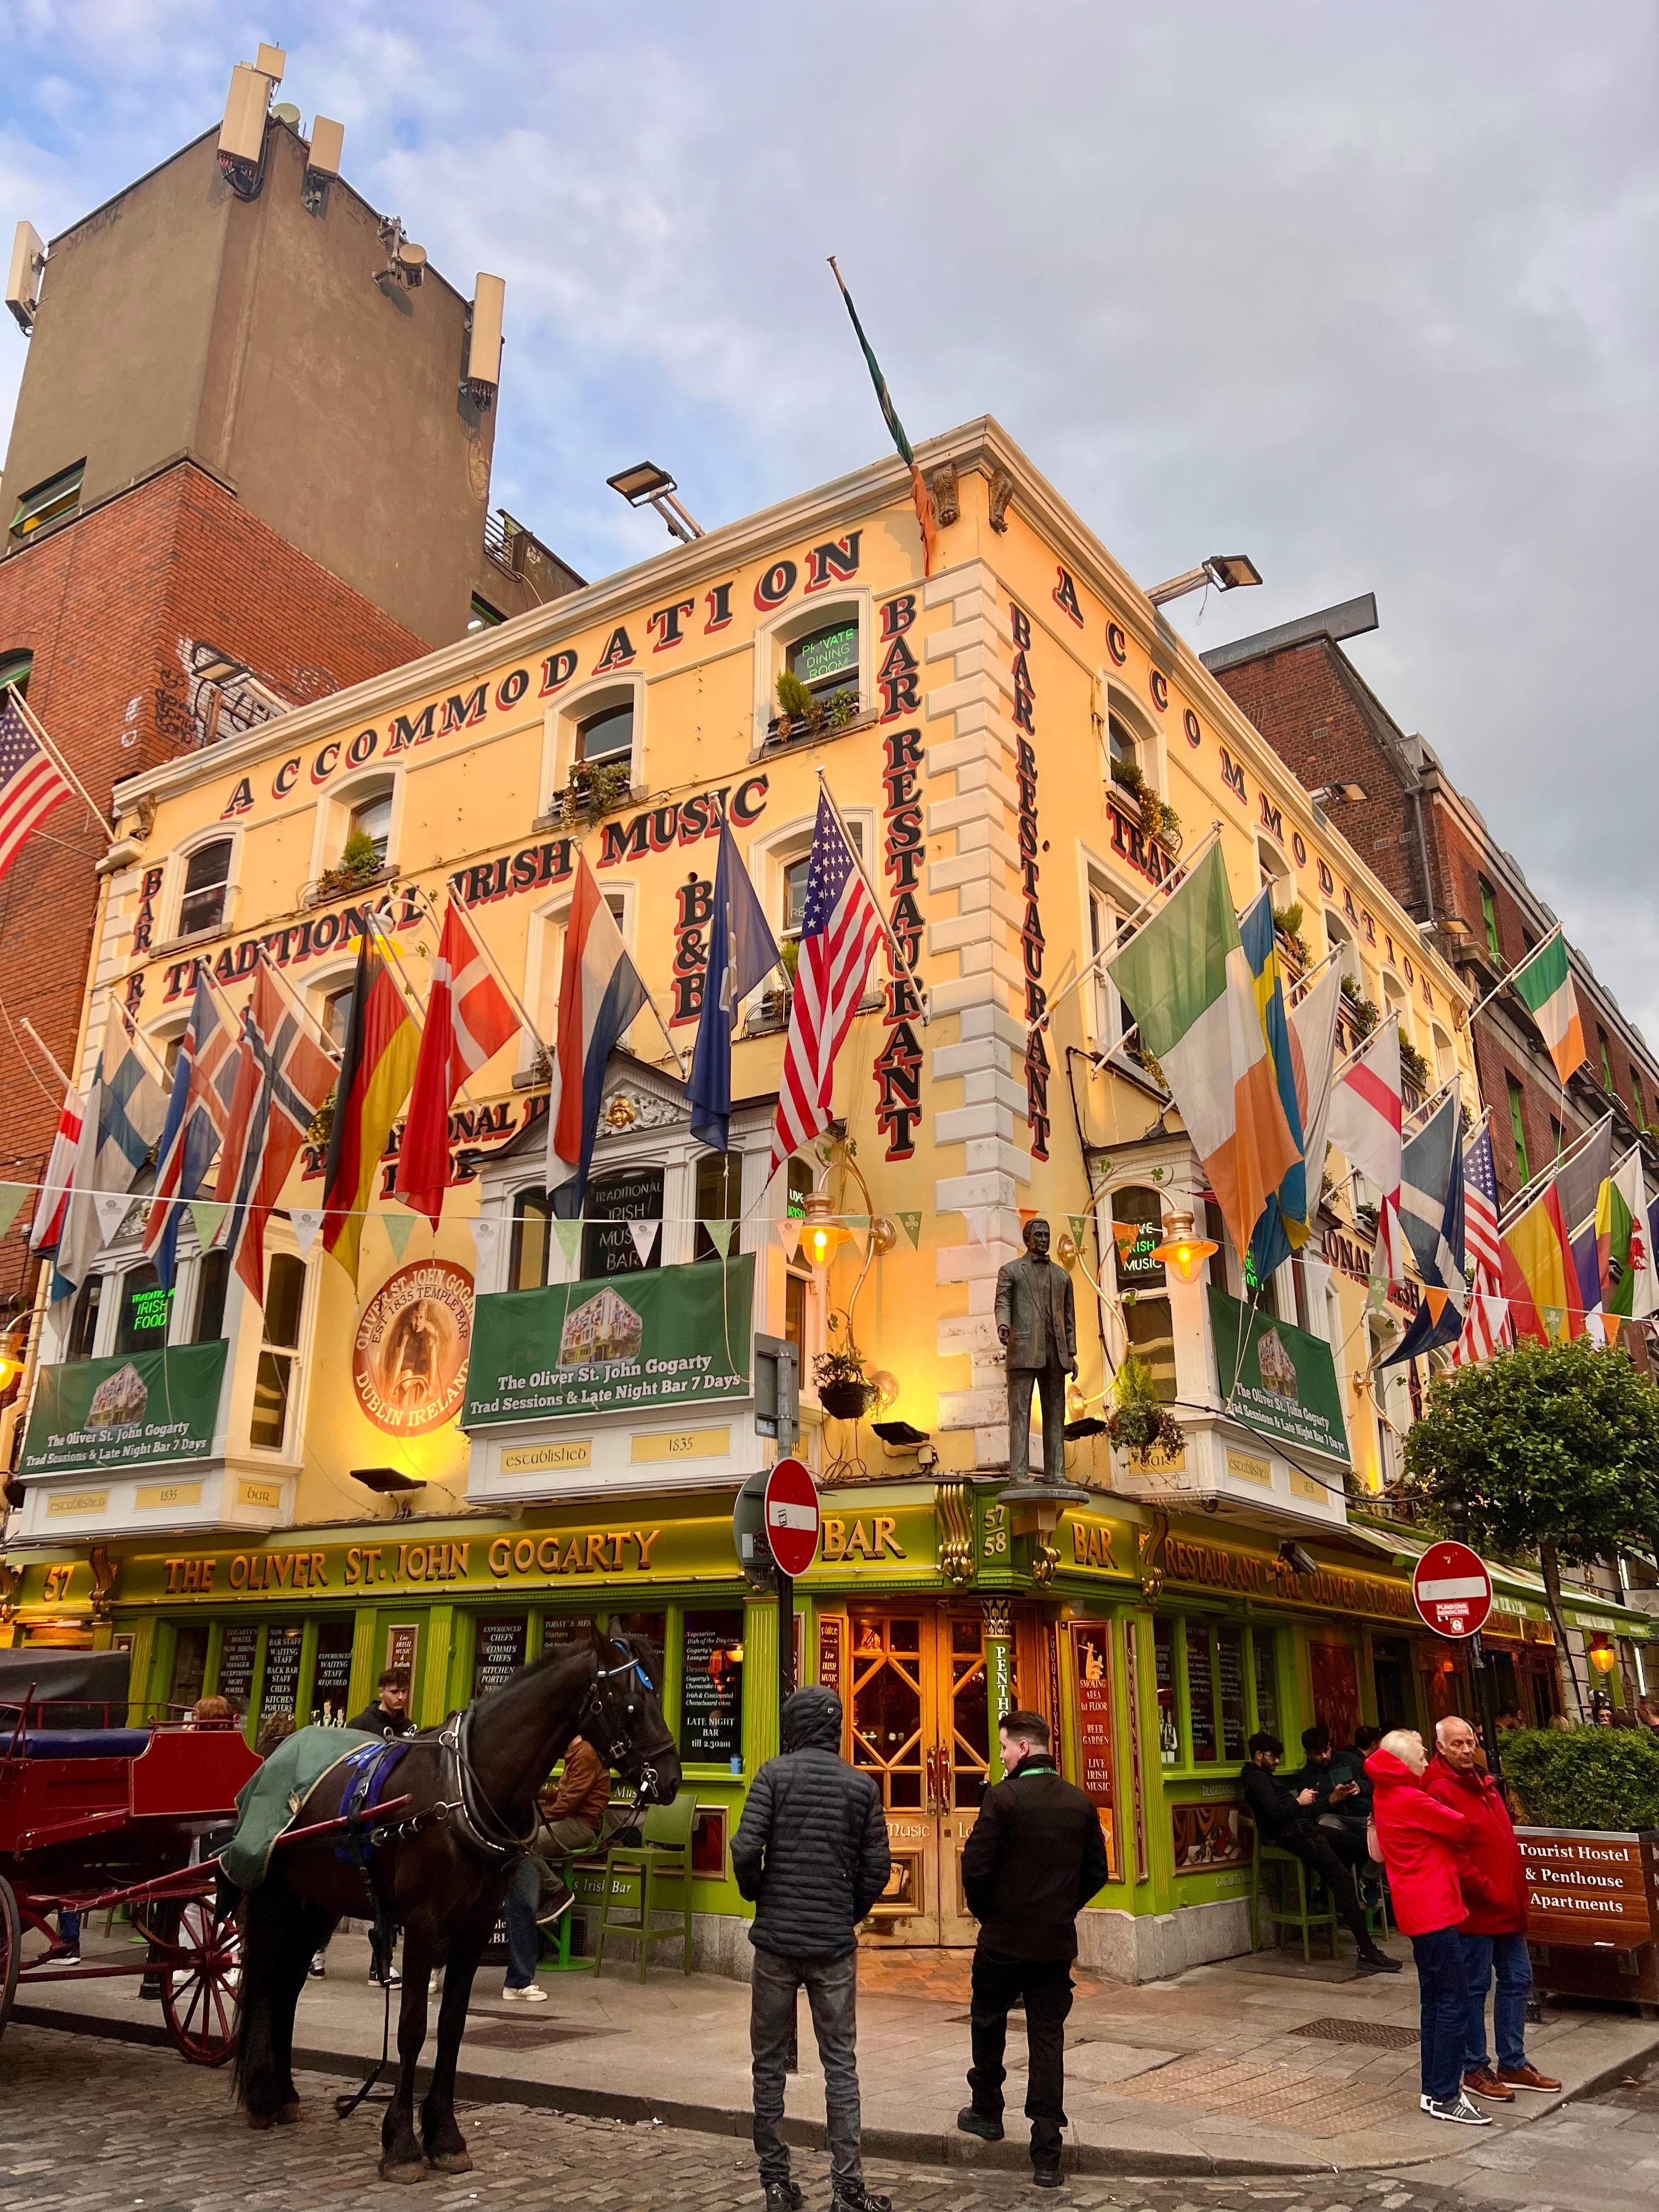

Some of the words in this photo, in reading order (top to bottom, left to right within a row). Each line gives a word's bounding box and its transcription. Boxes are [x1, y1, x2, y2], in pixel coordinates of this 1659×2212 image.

[806, 643, 850, 669] DINING
[880, 594, 922, 725] BAR
[221, 529, 864, 819] ACCOMMODATION
[1009, 602, 1036, 736] BAR
[1052, 566, 1434, 1011] ACCOMMODATION
[597, 774, 770, 868] MUSIC
[131, 867, 164, 957] BAR
[873, 727, 926, 1162] RESTAURANT
[1015, 733, 1051, 1163] RESTAURANT
[595, 1182, 663, 1203] TRADITIONAL
[608, 1202, 645, 1221] IRISH
[606, 1250, 641, 1271] BAR
[1124, 1259, 1162, 1272] MUSIC
[391, 1276, 408, 1295] ST
[410, 1267, 447, 1289] JOHN
[137, 1299, 169, 1316] IRISH
[388, 1291, 414, 1316] 1835
[417, 1286, 456, 1312] TEMPLE
[455, 1308, 469, 1340] BAR
[134, 1313, 167, 1330] FOOD
[498, 1374, 526, 1391] The
[529, 1369, 574, 1387] Oliver
[577, 1366, 600, 1383] St.
[603, 1361, 641, 1383] John
[645, 1354, 713, 1375] Gogarty
[356, 1369, 404, 1427] DUBLIN
[408, 1358, 470, 1427] IRELAND
[470, 1398, 500, 1415] Trad
[502, 1392, 563, 1412] Sessions
[566, 1391, 578, 1404] &
[581, 1387, 612, 1403] Late
[614, 1380, 659, 1401] Night
[661, 1378, 688, 1393] Bar
[691, 1375, 701, 1390] 7
[703, 1372, 741, 1390] Days
[1234, 1381, 1251, 1400] The
[1252, 1387, 1274, 1409] Oliver
[1274, 1397, 1286, 1413] St.
[1286, 1400, 1303, 1419] John
[1302, 1407, 1330, 1432] Gogarty
[47, 1435, 66, 1448] The
[66, 1431, 97, 1445] Oliver
[98, 1430, 114, 1442] St.
[115, 1426, 143, 1443] John
[144, 1421, 190, 1436] Gogarty
[1243, 1404, 1274, 1426] Sessions
[1274, 1415, 1281, 1429] &
[1280, 1418, 1296, 1435] Late
[1294, 1422, 1314, 1441] Night
[1313, 1431, 1324, 1444] Bar
[1329, 1435, 1345, 1453] Days
[26, 1454, 47, 1467] Trad
[47, 1451, 87, 1464] Sessions
[88, 1449, 98, 1460] &
[99, 1447, 121, 1460] Late
[122, 1442, 152, 1458] Night
[153, 1441, 171, 1453] Bar
[173, 1440, 180, 1451] 7
[181, 1438, 207, 1453] Days
[505, 1447, 586, 1468] established
[668, 1437, 694, 1452] 1835
[160, 1488, 178, 1502] 1835
[983, 1505, 1005, 1528] 57
[820, 1516, 908, 1562] BAR
[982, 1533, 1007, 1558] 58
[1071, 1522, 1119, 1570] BAR
[165, 1558, 217, 1594] THE
[228, 1552, 329, 1590] OLIVER
[345, 1547, 386, 1585] ST.
[393, 1542, 471, 1583] JOHN
[487, 1530, 662, 1578] GOGARTY
[44, 1565, 75, 1602] 57
[1164, 1537, 1261, 1594] RESTAURANT
[1384, 1582, 1412, 1618] JOHN
[483, 1626, 522, 1634] EXPERIENCED
[490, 1633, 514, 1642] CHEFS
[269, 1638, 283, 1646] BAR
[283, 1637, 302, 1646] STAFF
[487, 1645, 517, 1653] COMMIS
[686, 1646, 713, 1655] Gogarty's
[488, 1654, 512, 1662] CHEFS
[822, 1662, 837, 1671] IRISH
[323, 1669, 344, 1678] STAFF
[482, 1666, 515, 1674] KITCHEN
[821, 1673, 838, 1682] MUSIC
[270, 1685, 291, 1693] CHEFS
[1080, 1679, 1106, 1689] SMOKING
[265, 1695, 294, 1703] KITCHEN
[1086, 1690, 1101, 1700] AREA
[1089, 1701, 1108, 1711] FLOOR
[687, 1717, 707, 1726] LATE
[708, 1717, 735, 1726] NIGHT
[1087, 1724, 1104, 1734] BEER
[702, 1728, 719, 1737] BAR
[1082, 1735, 1109, 1746] GARDEN
[691, 1739, 702, 1748] till
[703, 1740, 731, 1749] 2.30am
[1087, 1758, 1106, 1769] LIVE
[1087, 1770, 1108, 1780] IRISH
[1086, 1781, 1111, 1792] MUSIC
[1517, 1843, 1575, 1858] Tourist
[1577, 1846, 1630, 1862] Hostel
[611, 1880, 631, 1894] Bar
[1525, 1867, 1537, 1881] &
[1541, 1868, 1624, 1888] Penthouse
[1530, 1892, 1624, 1914] Apartments
